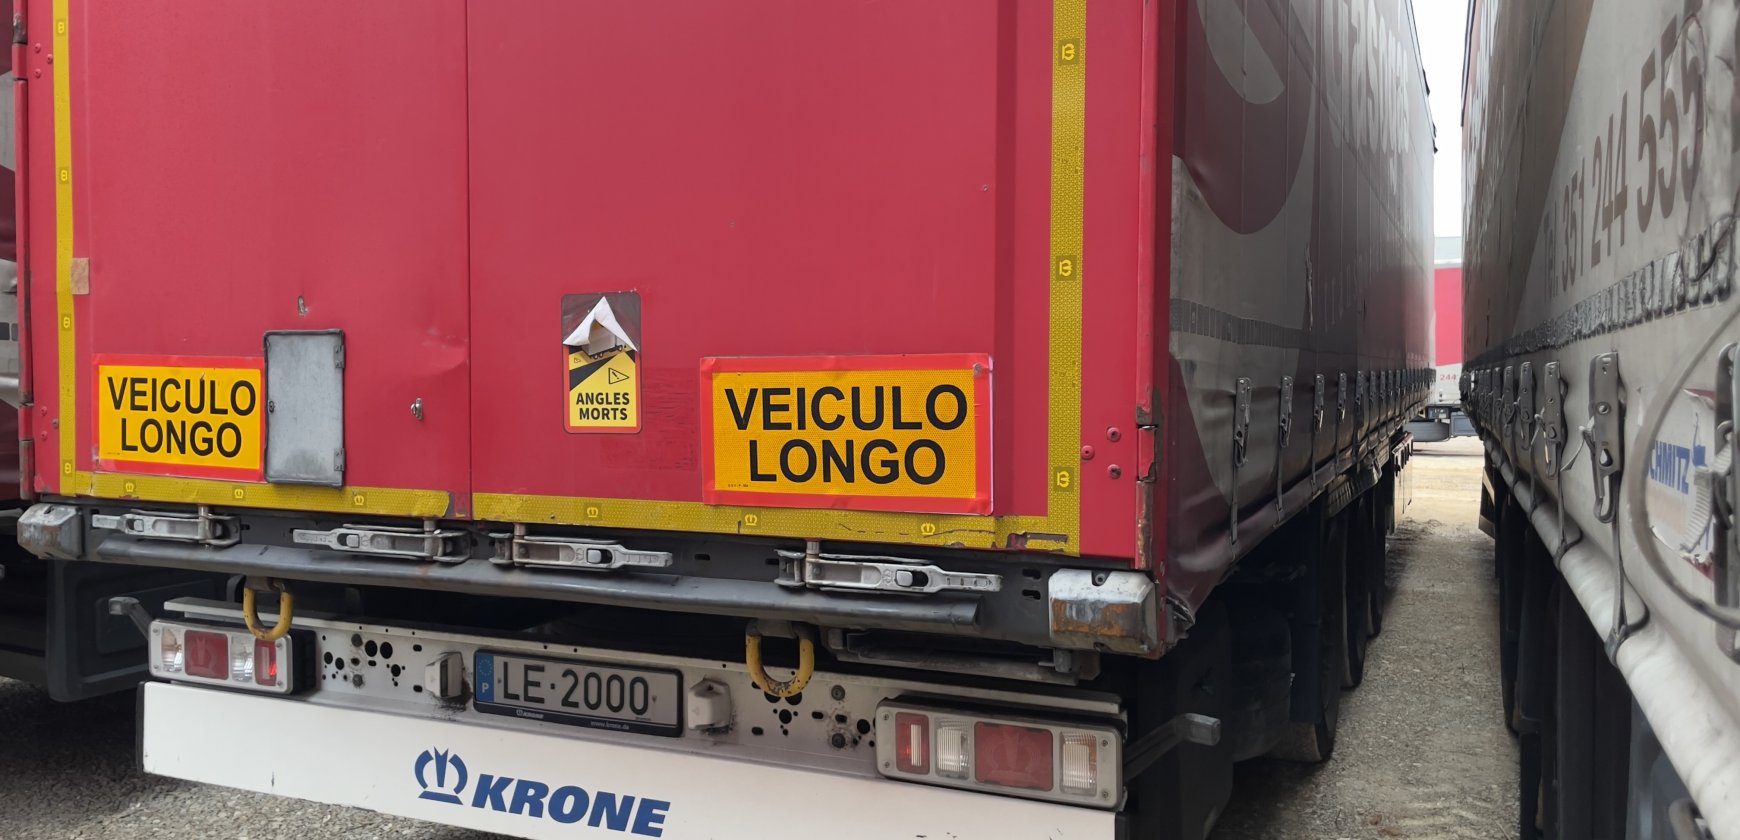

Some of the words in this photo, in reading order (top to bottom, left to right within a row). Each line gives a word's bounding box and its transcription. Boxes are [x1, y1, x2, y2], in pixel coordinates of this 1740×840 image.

[1561, 157, 1585, 292] 351
[1590, 90, 1628, 269] 244
[107, 377, 257, 417] VEICULO
[576, 392, 630, 406] ANGLES
[579, 408, 628, 421] MORTS
[725, 384, 968, 431] VEICULO
[121, 418, 242, 458] LONGO
[749, 439, 946, 485] LONGO
[482, 683, 489, 694] P
[472, 773, 671, 838] KRONE
